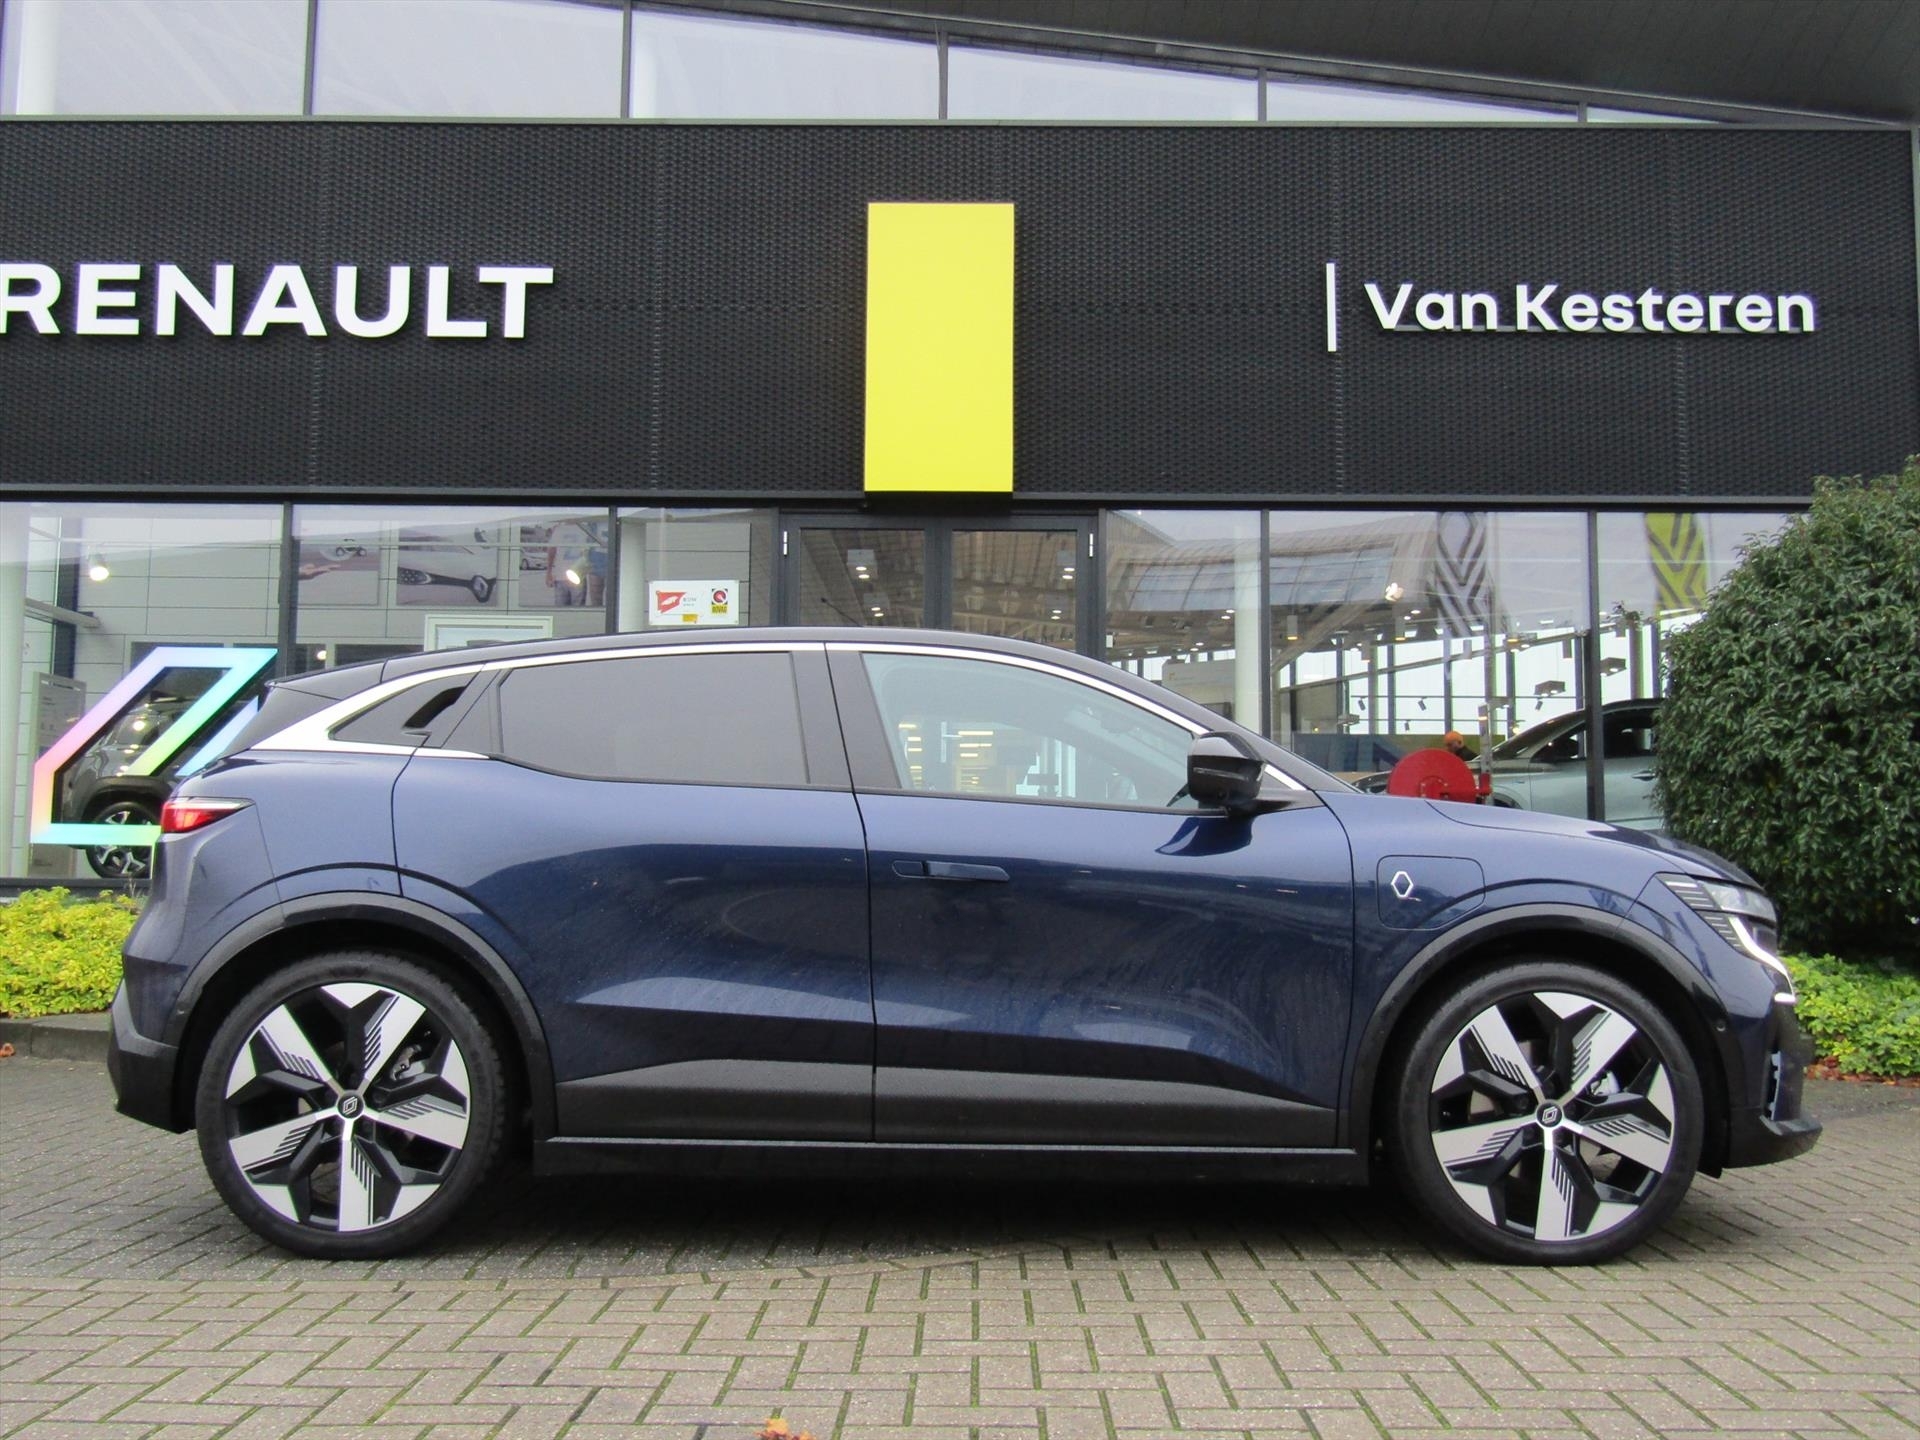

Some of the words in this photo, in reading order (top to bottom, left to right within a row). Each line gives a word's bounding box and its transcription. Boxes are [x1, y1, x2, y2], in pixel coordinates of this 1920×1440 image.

[0, 262, 555, 339] RENAULT
[1363, 282, 1499, 331] Van
[1515, 283, 1816, 333] Kesteren
